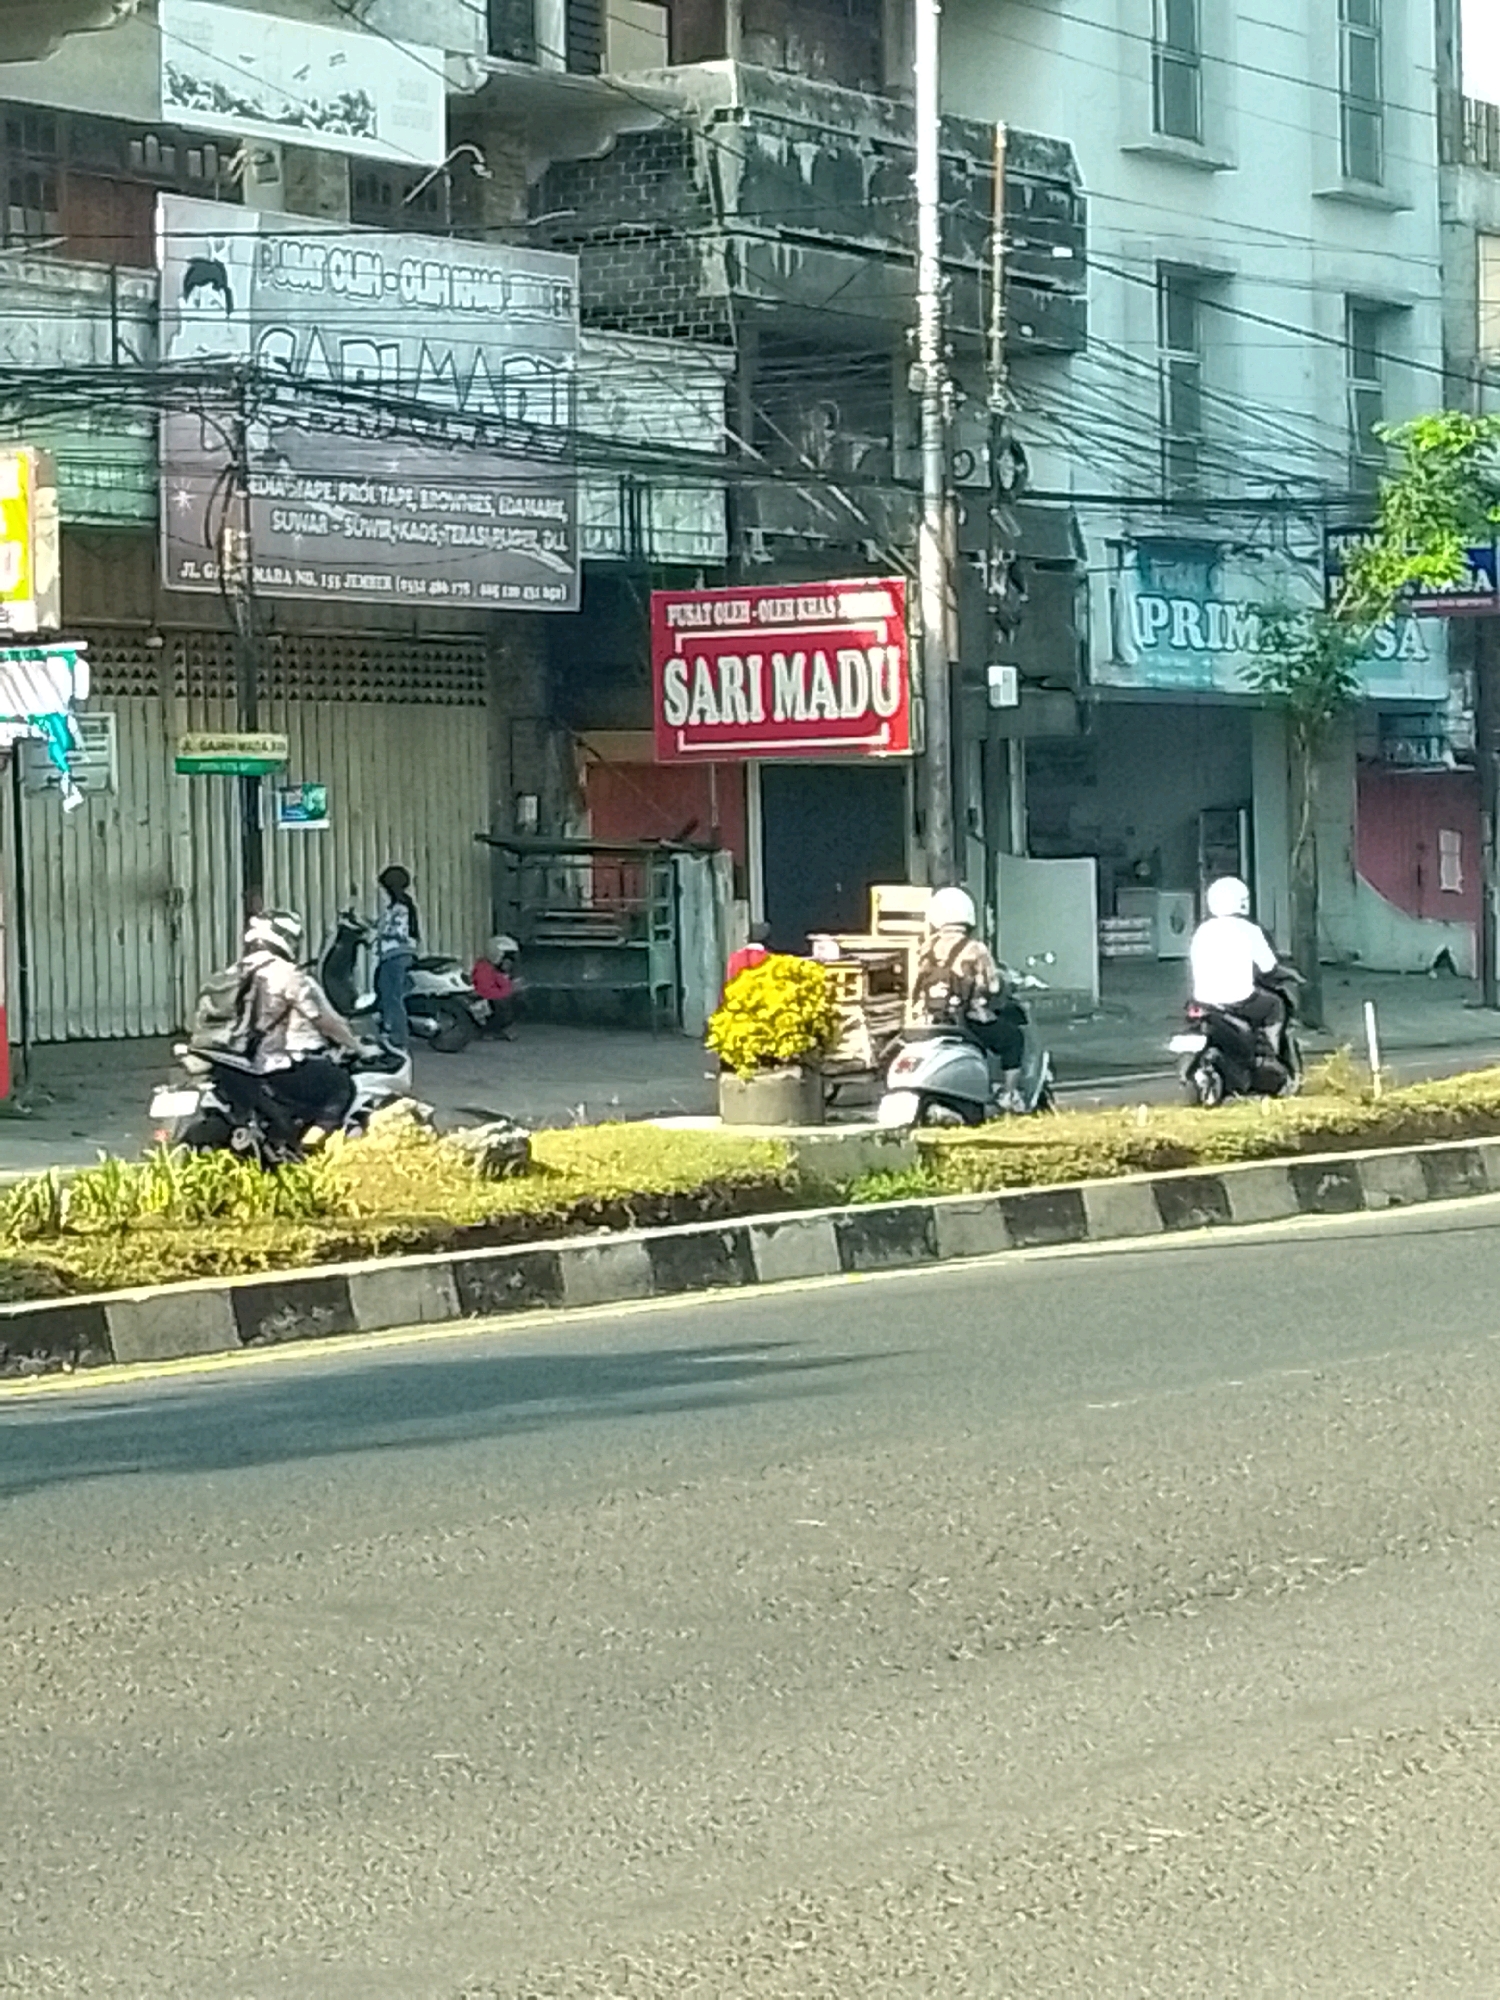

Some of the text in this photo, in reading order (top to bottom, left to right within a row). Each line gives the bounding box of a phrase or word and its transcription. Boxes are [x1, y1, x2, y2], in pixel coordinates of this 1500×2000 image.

[272, 509, 329, 534] SUWAR
[180, 560, 201, 579] JL.
[666, 600, 714, 627] PUSAT
[714, 599, 751, 626] OLEH
[758, 597, 795, 623] OLEH
[796, 595, 836, 622] KHAS
[663, 645, 901, 727] SARI MADU
